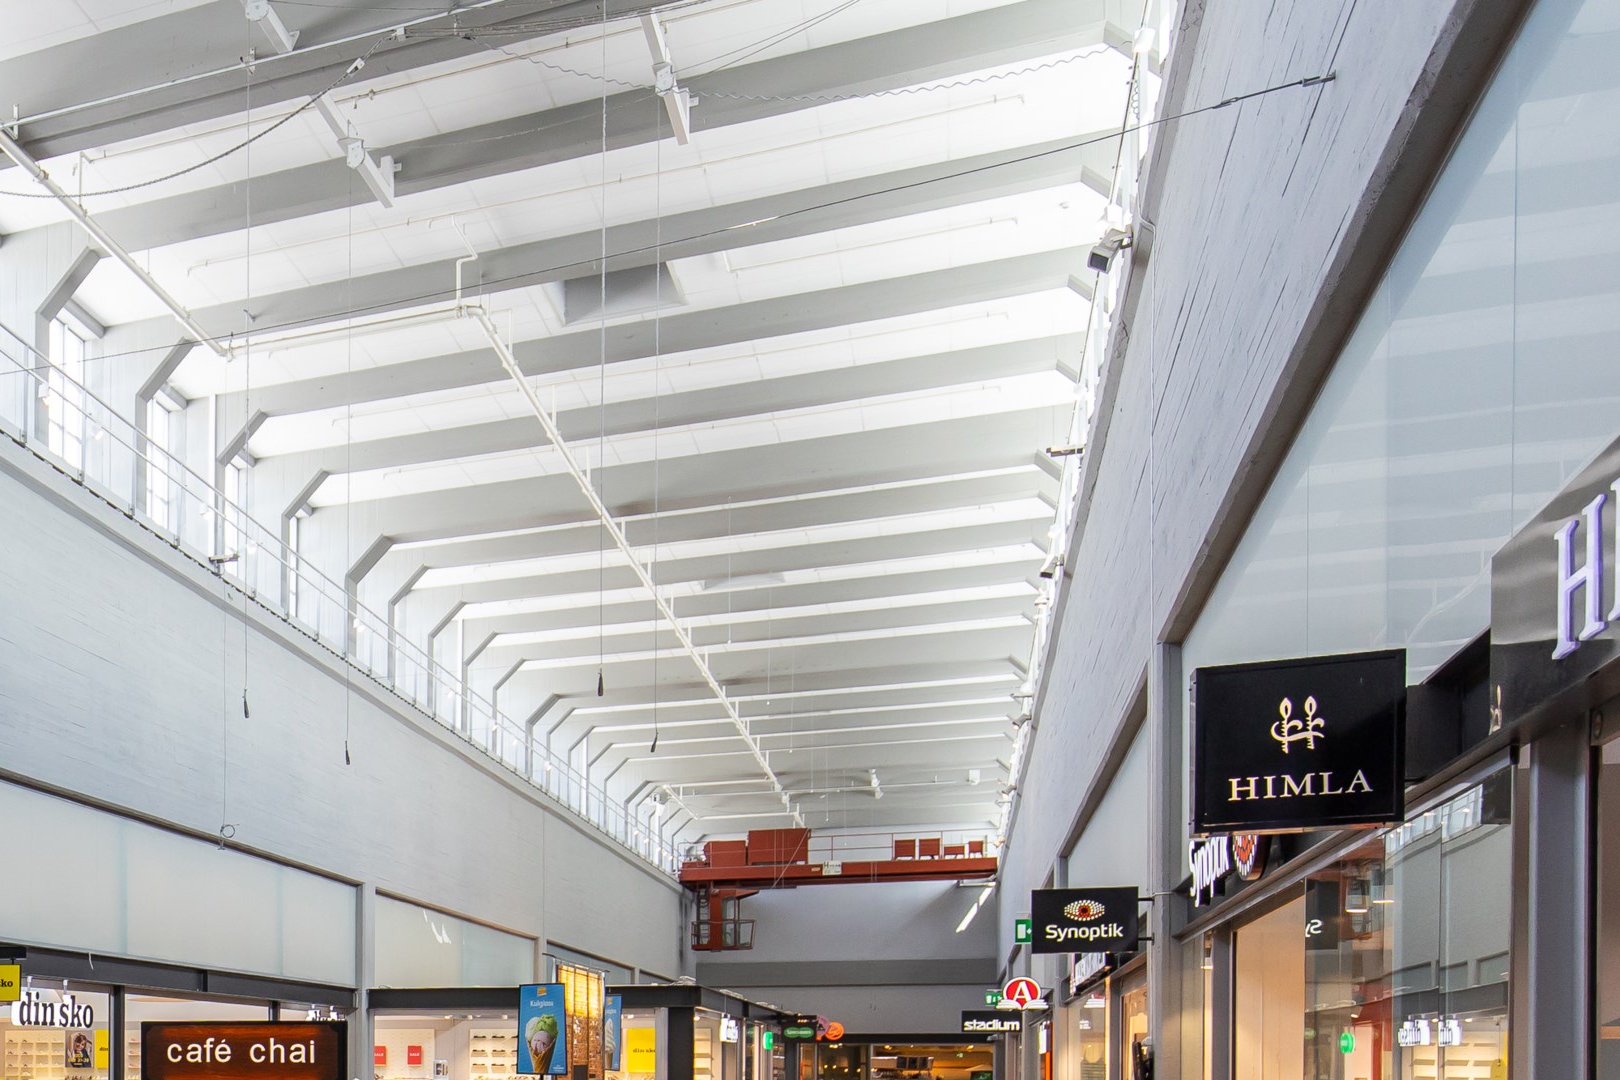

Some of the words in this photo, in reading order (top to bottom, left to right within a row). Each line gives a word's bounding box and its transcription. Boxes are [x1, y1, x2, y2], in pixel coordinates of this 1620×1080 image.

[1229, 769, 1373, 801] HIMLA
[1045, 923, 1123, 942] Synoptik
[19, 992, 55, 1026] din
[59, 995, 94, 1028] sko
[964, 1019, 1020, 1031] stadium
[167, 1036, 232, 1063] café
[249, 1038, 315, 1064] chai
